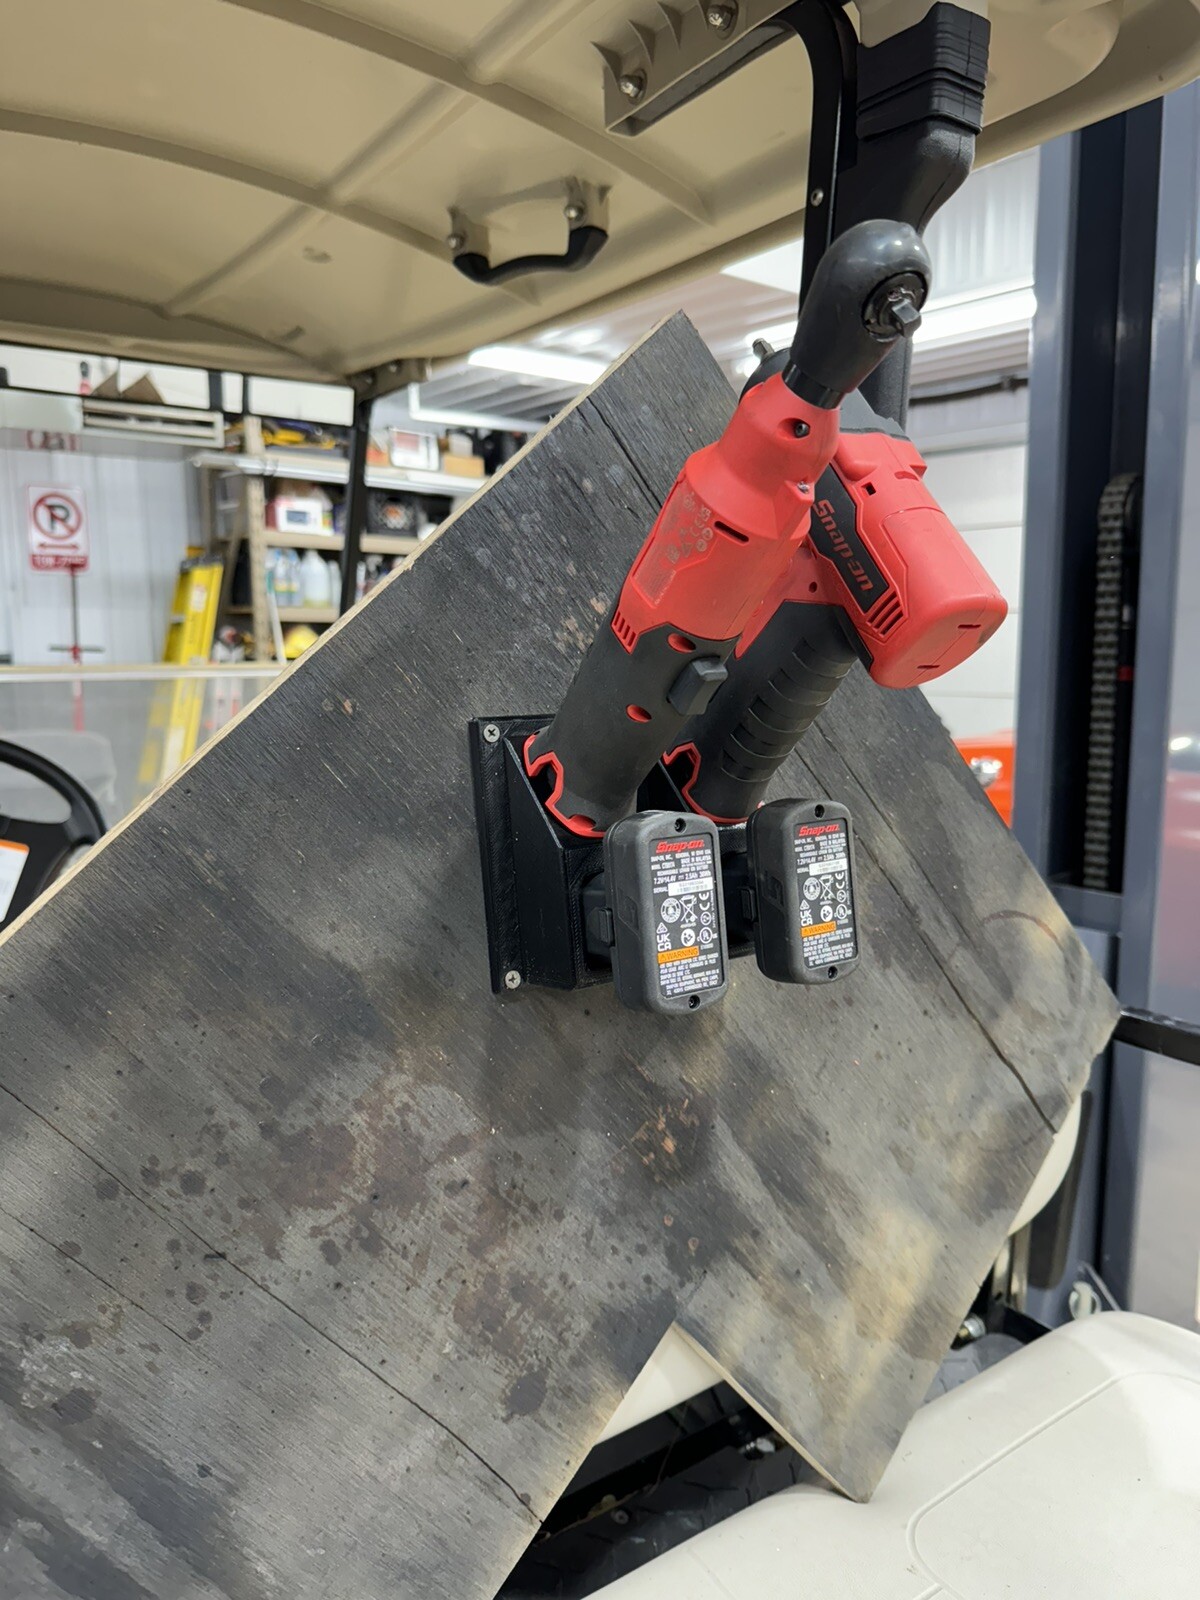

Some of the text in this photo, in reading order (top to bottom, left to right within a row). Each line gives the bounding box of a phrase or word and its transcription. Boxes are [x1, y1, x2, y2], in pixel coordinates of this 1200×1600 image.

[799, 824, 840, 837] Snap-on
[656, 839, 705, 854] Snap-on
[800, 909, 812, 918] UK
[800, 918, 813, 926] CA
[808, 922, 836, 934] WARNING
[656, 933, 671, 943] UK
[657, 942, 672, 952] CA
[666, 948, 698, 959] WARNING
